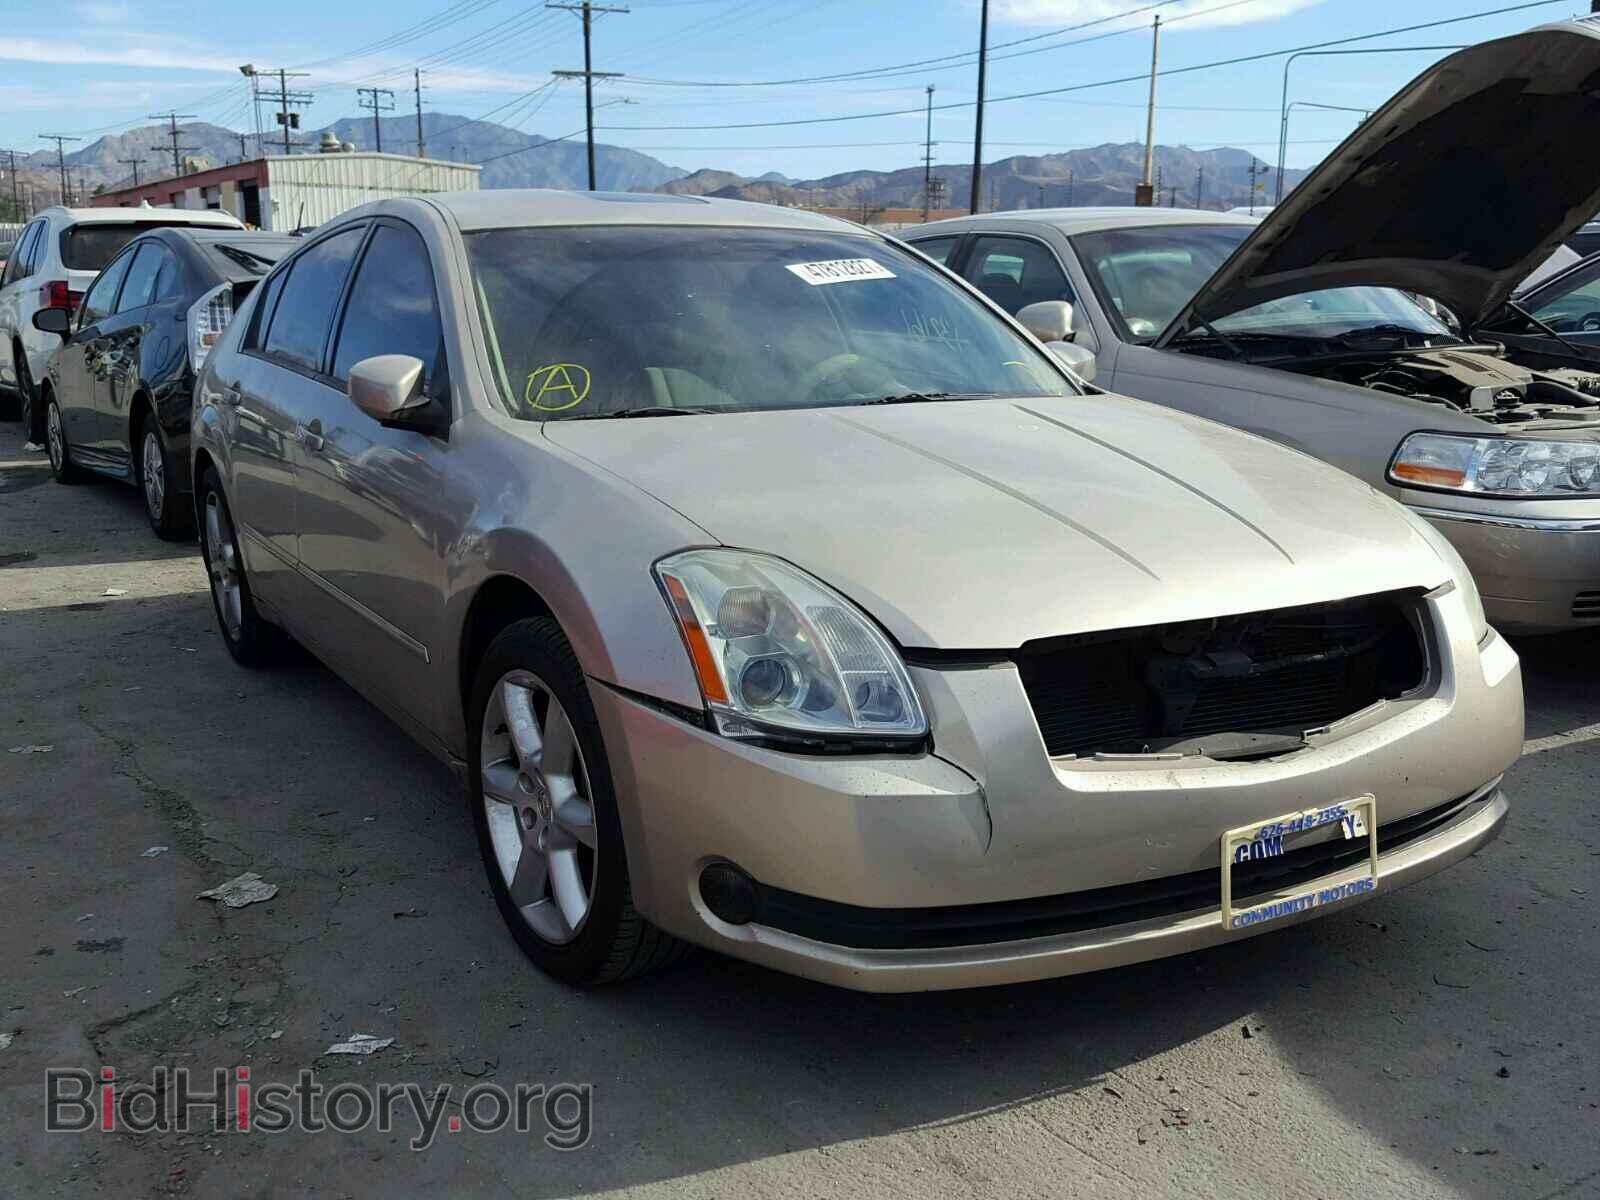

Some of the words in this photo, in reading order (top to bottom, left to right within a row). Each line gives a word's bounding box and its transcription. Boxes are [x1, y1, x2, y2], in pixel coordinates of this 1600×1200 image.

[532, 365, 578, 408] A
[1232, 893, 1318, 928] COMMUNITY
[1319, 878, 1374, 905] MOTORS
